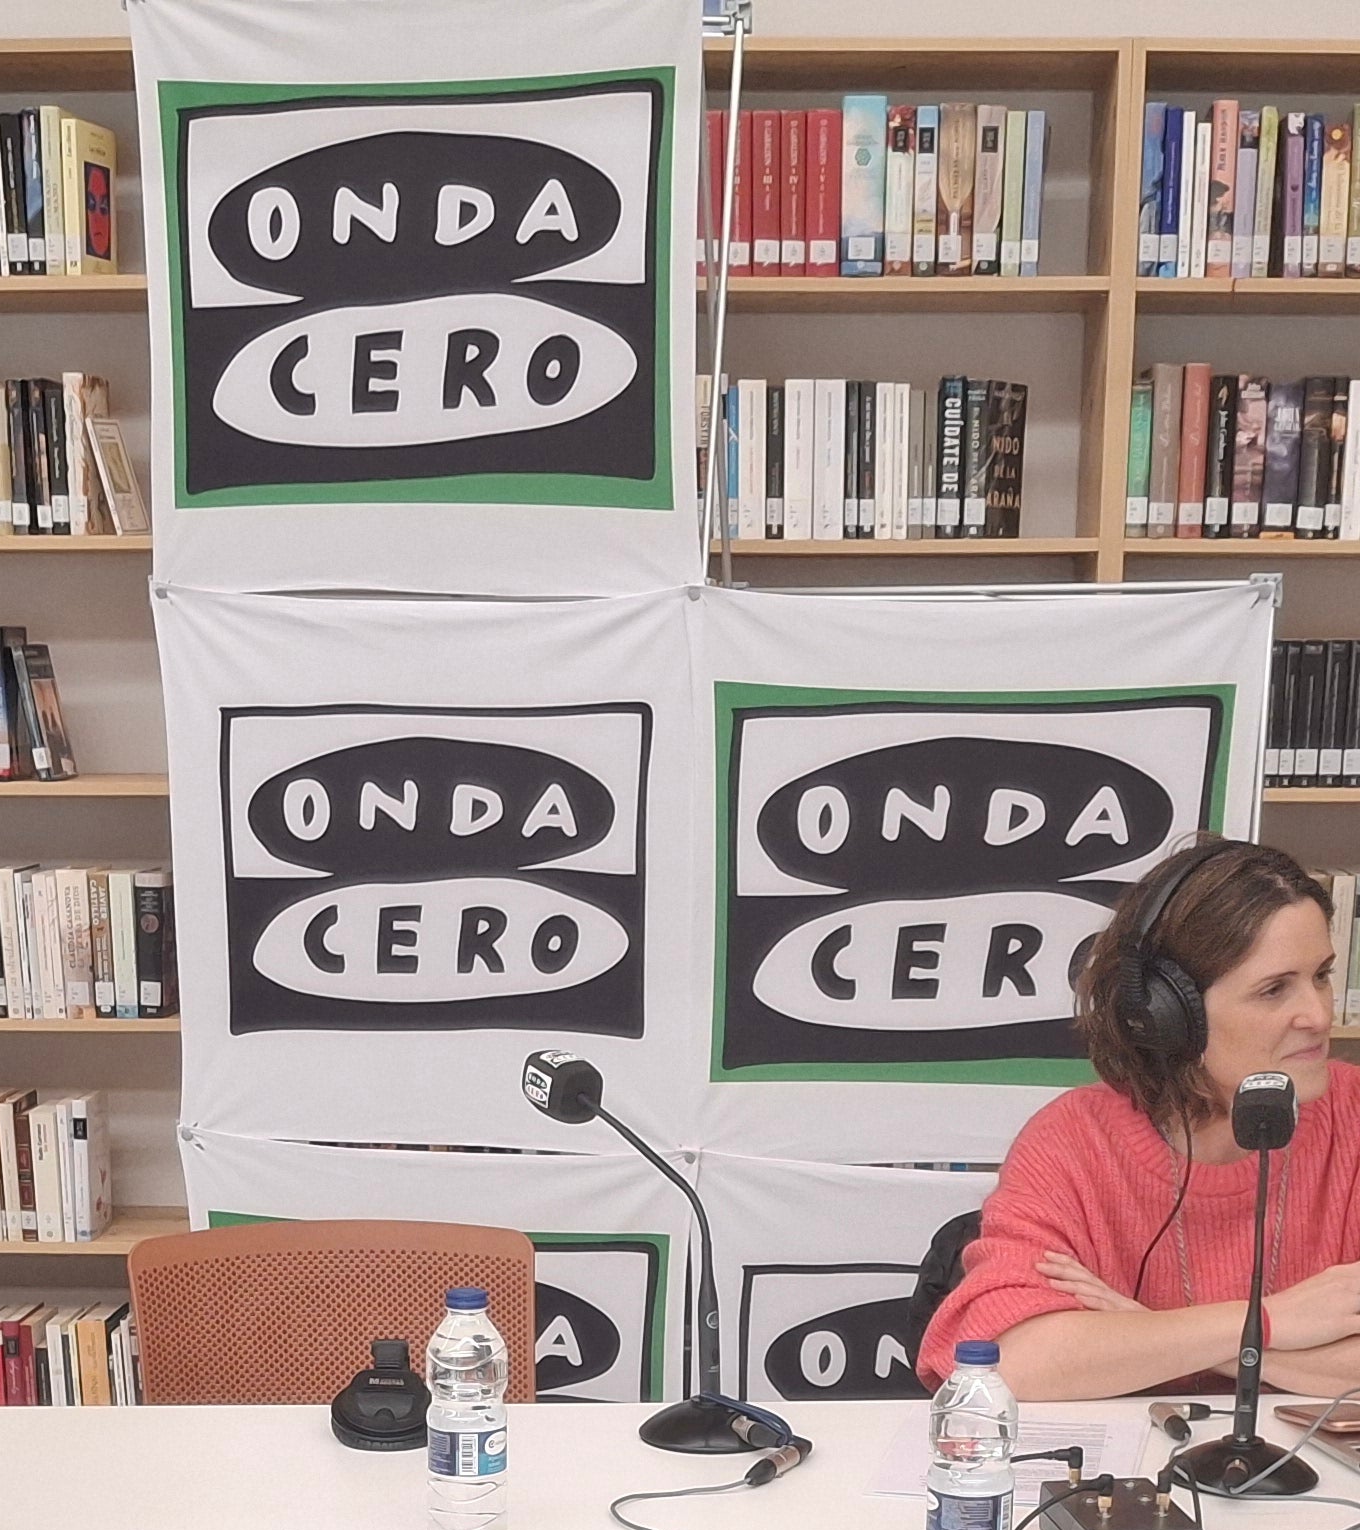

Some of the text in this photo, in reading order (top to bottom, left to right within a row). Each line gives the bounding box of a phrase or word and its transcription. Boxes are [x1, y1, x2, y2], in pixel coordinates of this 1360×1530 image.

[247, 178, 579, 261] ONDA
[269, 327, 581, 416] CERO
[941, 397, 964, 494] CUÍDATE DE
[992, 436, 1020, 455] NIDO
[281, 777, 579, 841] ONDA
[795, 782, 1130, 856] ONDA
[90, 880, 101, 925] CASTILLO
[99, 885, 108, 920] JAVIER
[303, 901, 581, 976] CERO
[800, 1330, 912, 1387] ON
